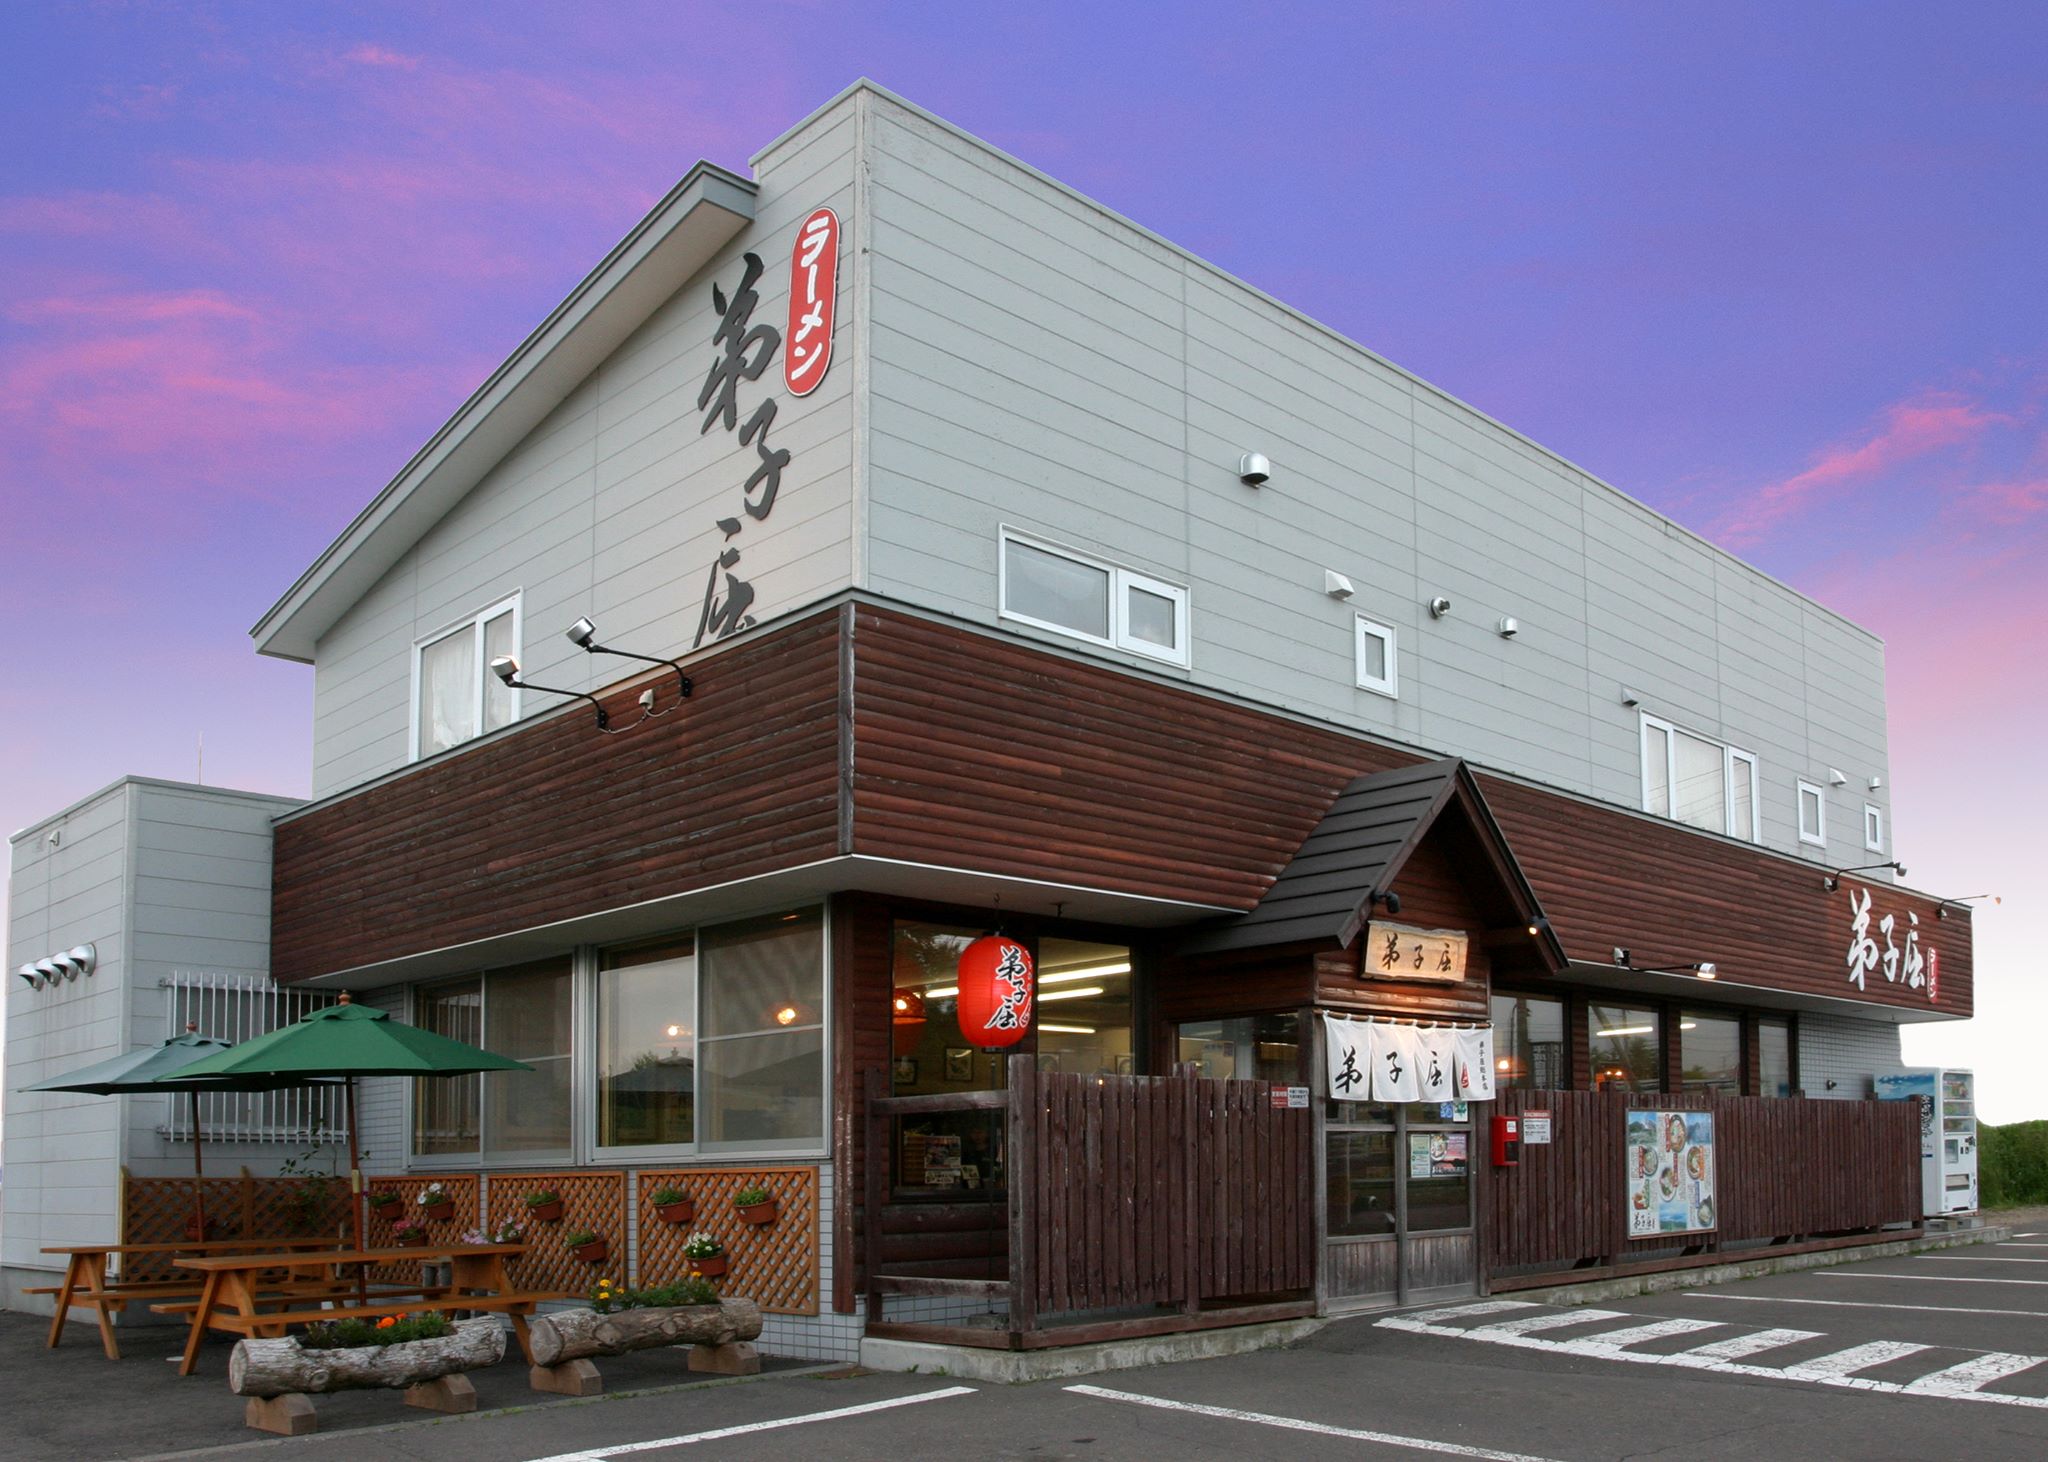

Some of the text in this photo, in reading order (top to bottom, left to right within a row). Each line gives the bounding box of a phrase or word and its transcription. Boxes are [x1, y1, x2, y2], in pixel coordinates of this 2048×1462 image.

[792, 215, 830, 381] ラーメン
[694, 253, 790, 648] 弟子屈
[1382, 934, 1452, 972] 弟子屈
[1846, 888, 1926, 992] 弟子屈
[1929, 948, 1937, 998] ラーメン
[985, 946, 1026, 1030] 弟子屈
[1335, 1045, 1442, 1093] 弟子屈
